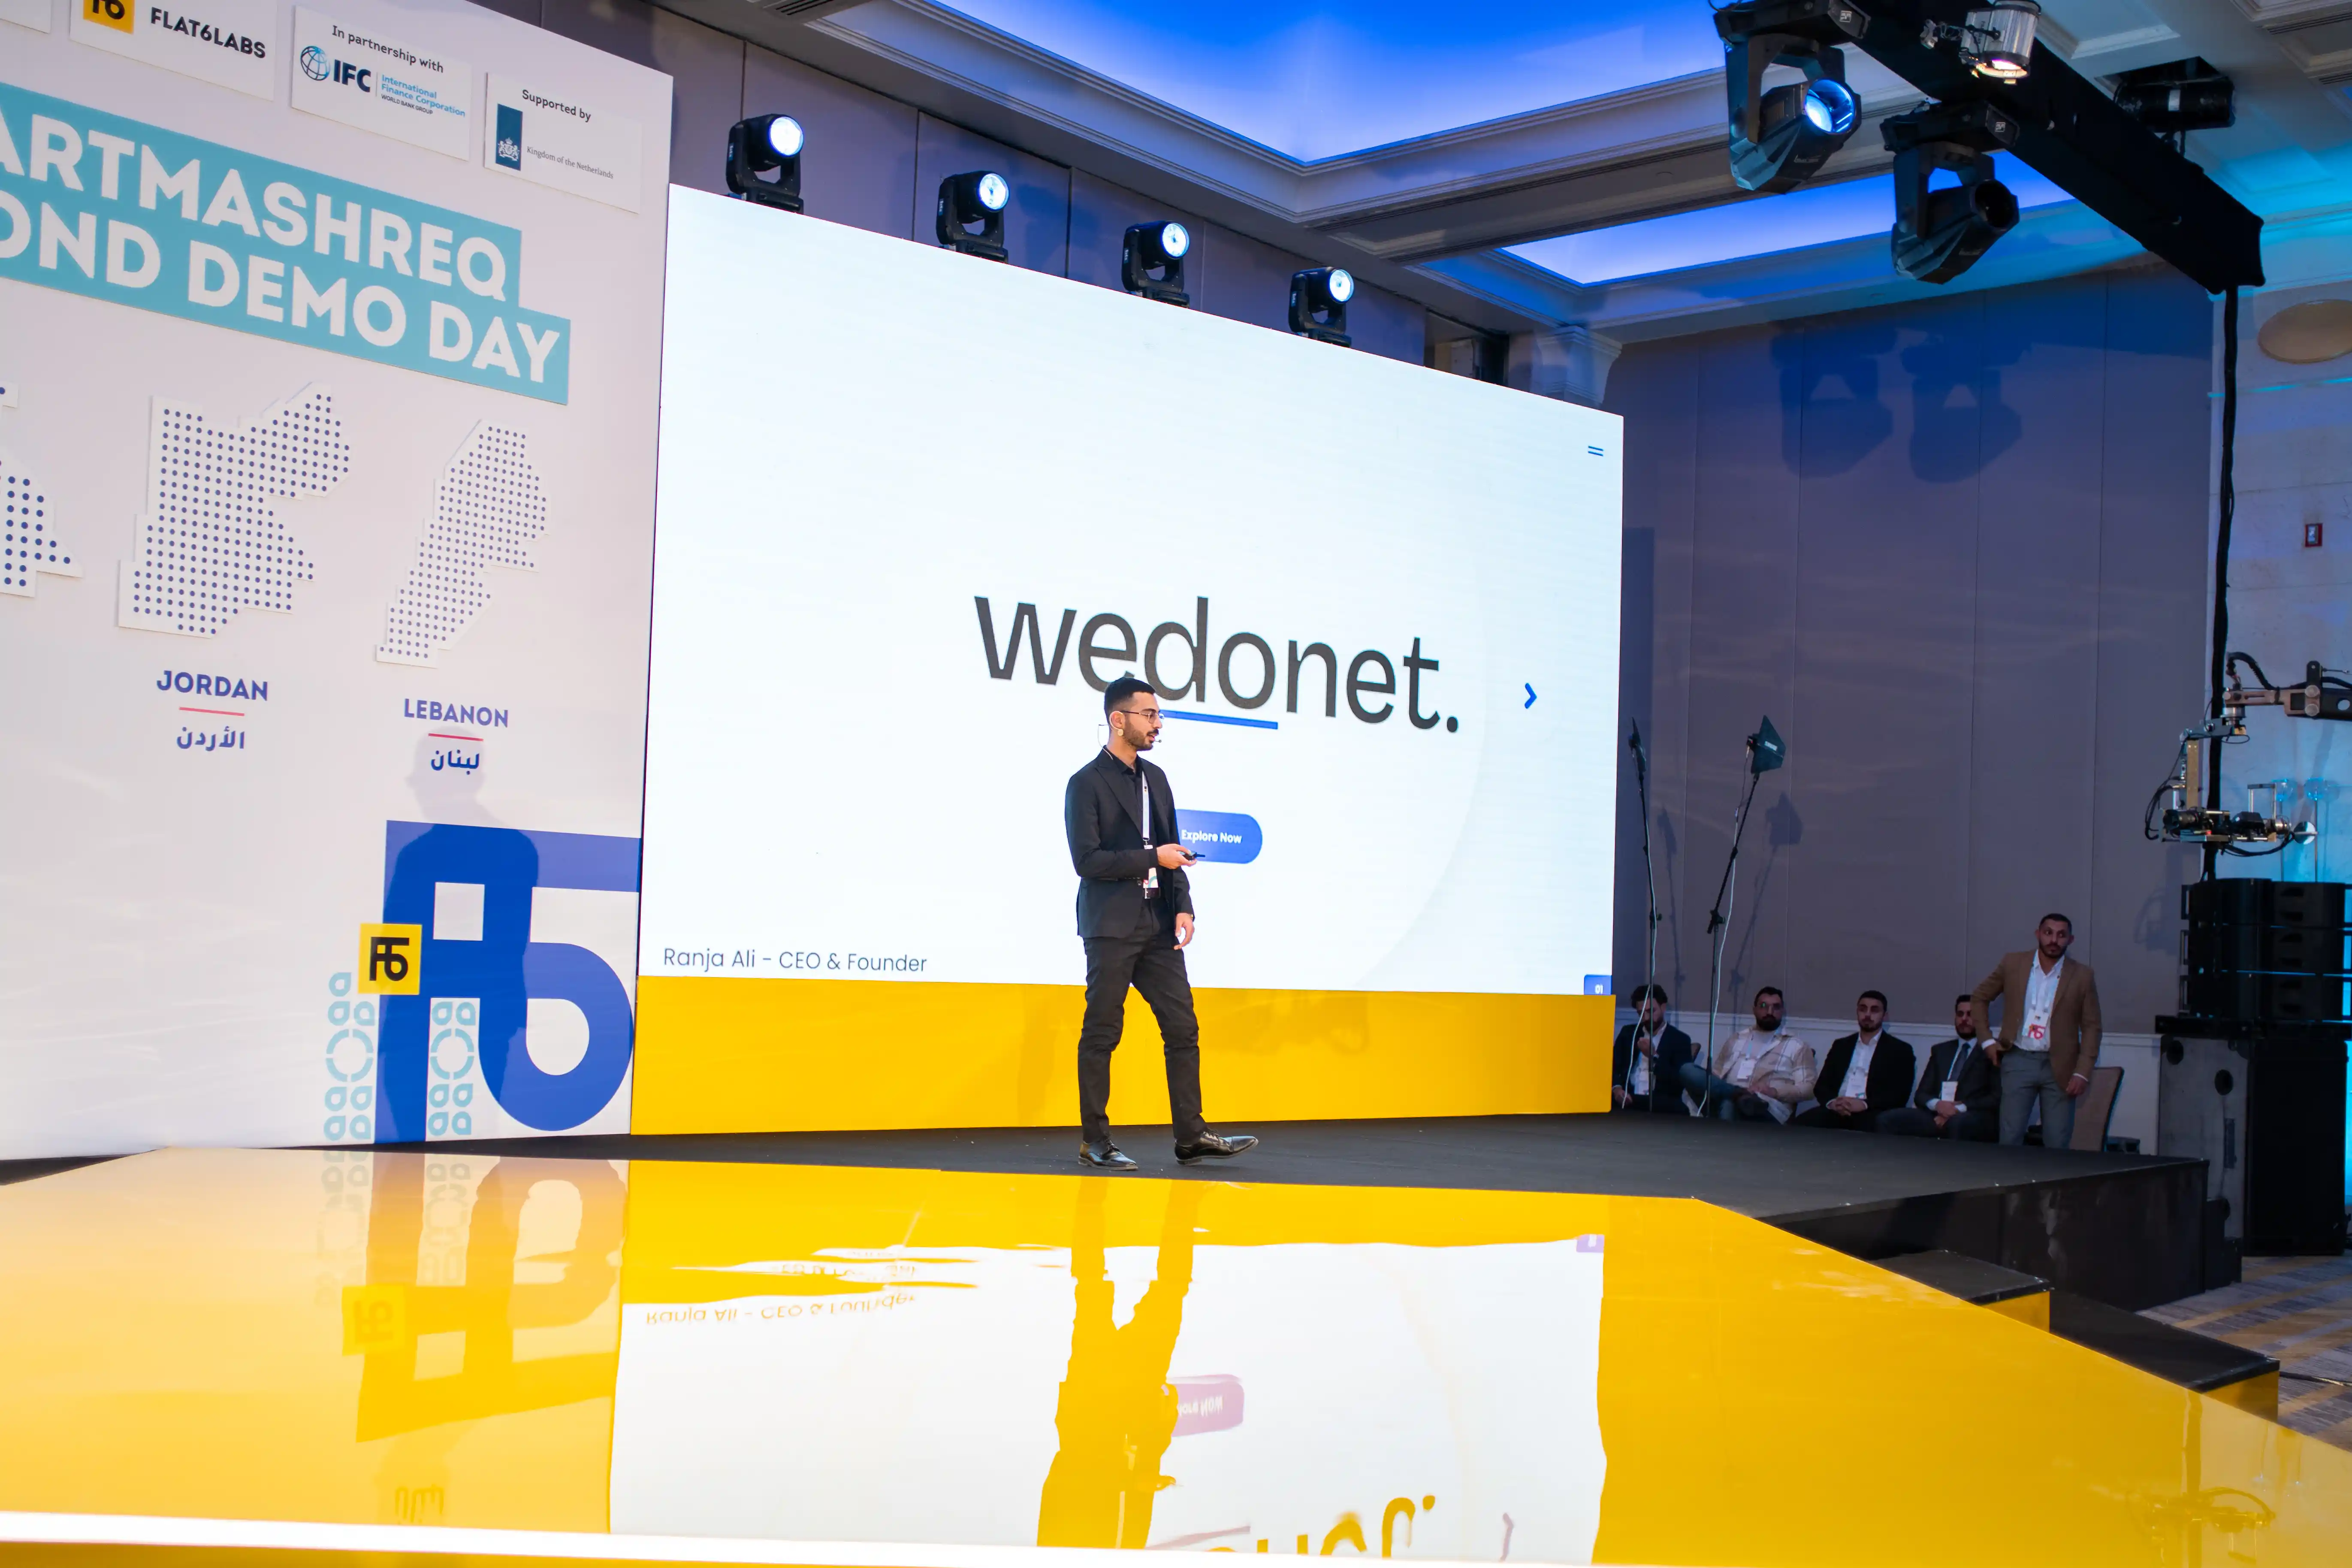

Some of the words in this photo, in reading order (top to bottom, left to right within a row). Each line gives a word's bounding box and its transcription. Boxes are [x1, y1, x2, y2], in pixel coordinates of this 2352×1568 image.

[151, 7, 266, 58] FLAT6LABS
[332, 25, 344, 39] In
[348, 33, 416, 65] partnership
[419, 58, 444, 73] with
[334, 59, 371, 93] IFC
[382, 75, 437, 99] International
[381, 84, 414, 100] Finance
[416, 95, 465, 117] Corporation
[381, 94, 400, 105] WORLD
[401, 100, 415, 109] BANK
[415, 105, 433, 115] GROUP
[522, 89, 576, 116] Supported
[579, 108, 591, 123] by
[527, 146, 555, 161] Kingdom
[565, 159, 575, 167] the
[577, 162, 613, 179] Netherlands
[188, 240, 406, 347] DEMO
[429, 300, 560, 383] DAY
[974, 596, 1459, 734] wedonet.
[157, 670, 268, 701] JORDAN
[404, 698, 508, 728] LEBANON
[177, 725, 245, 752] الأردن
[431, 749, 480, 775] لبنان
[1181, 829, 1219, 843] Explore
[1220, 832, 1242, 844] Now
[664, 947, 724, 973] Ranja
[732, 949, 755, 968] Ali
[779, 951, 821, 970] CEO
[827, 952, 841, 971] &
[848, 953, 927, 973] Founder
